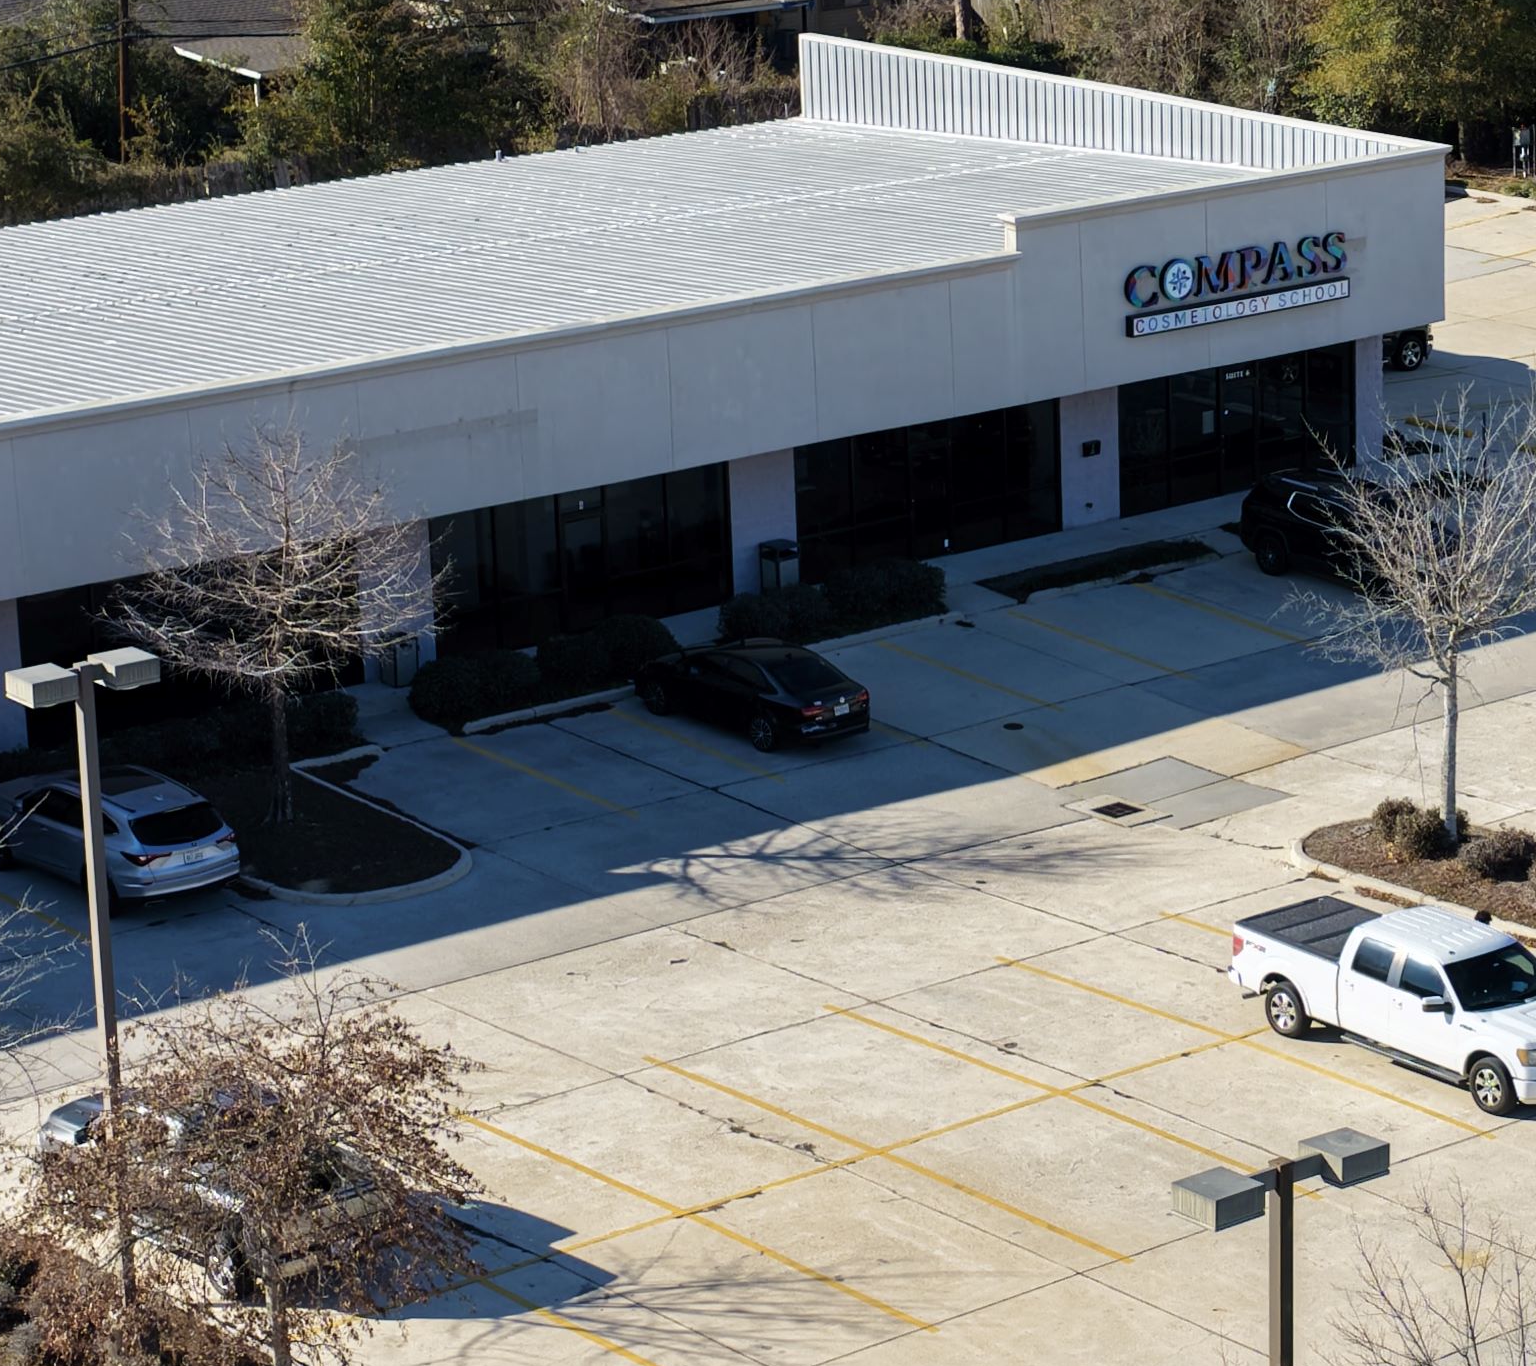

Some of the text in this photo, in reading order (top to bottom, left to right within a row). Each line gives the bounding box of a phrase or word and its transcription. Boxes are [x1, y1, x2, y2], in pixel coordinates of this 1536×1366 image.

[1124, 232, 1348, 309] COMPASS
[1135, 281, 1347, 334] COSMETOLOGY SCHOOL
